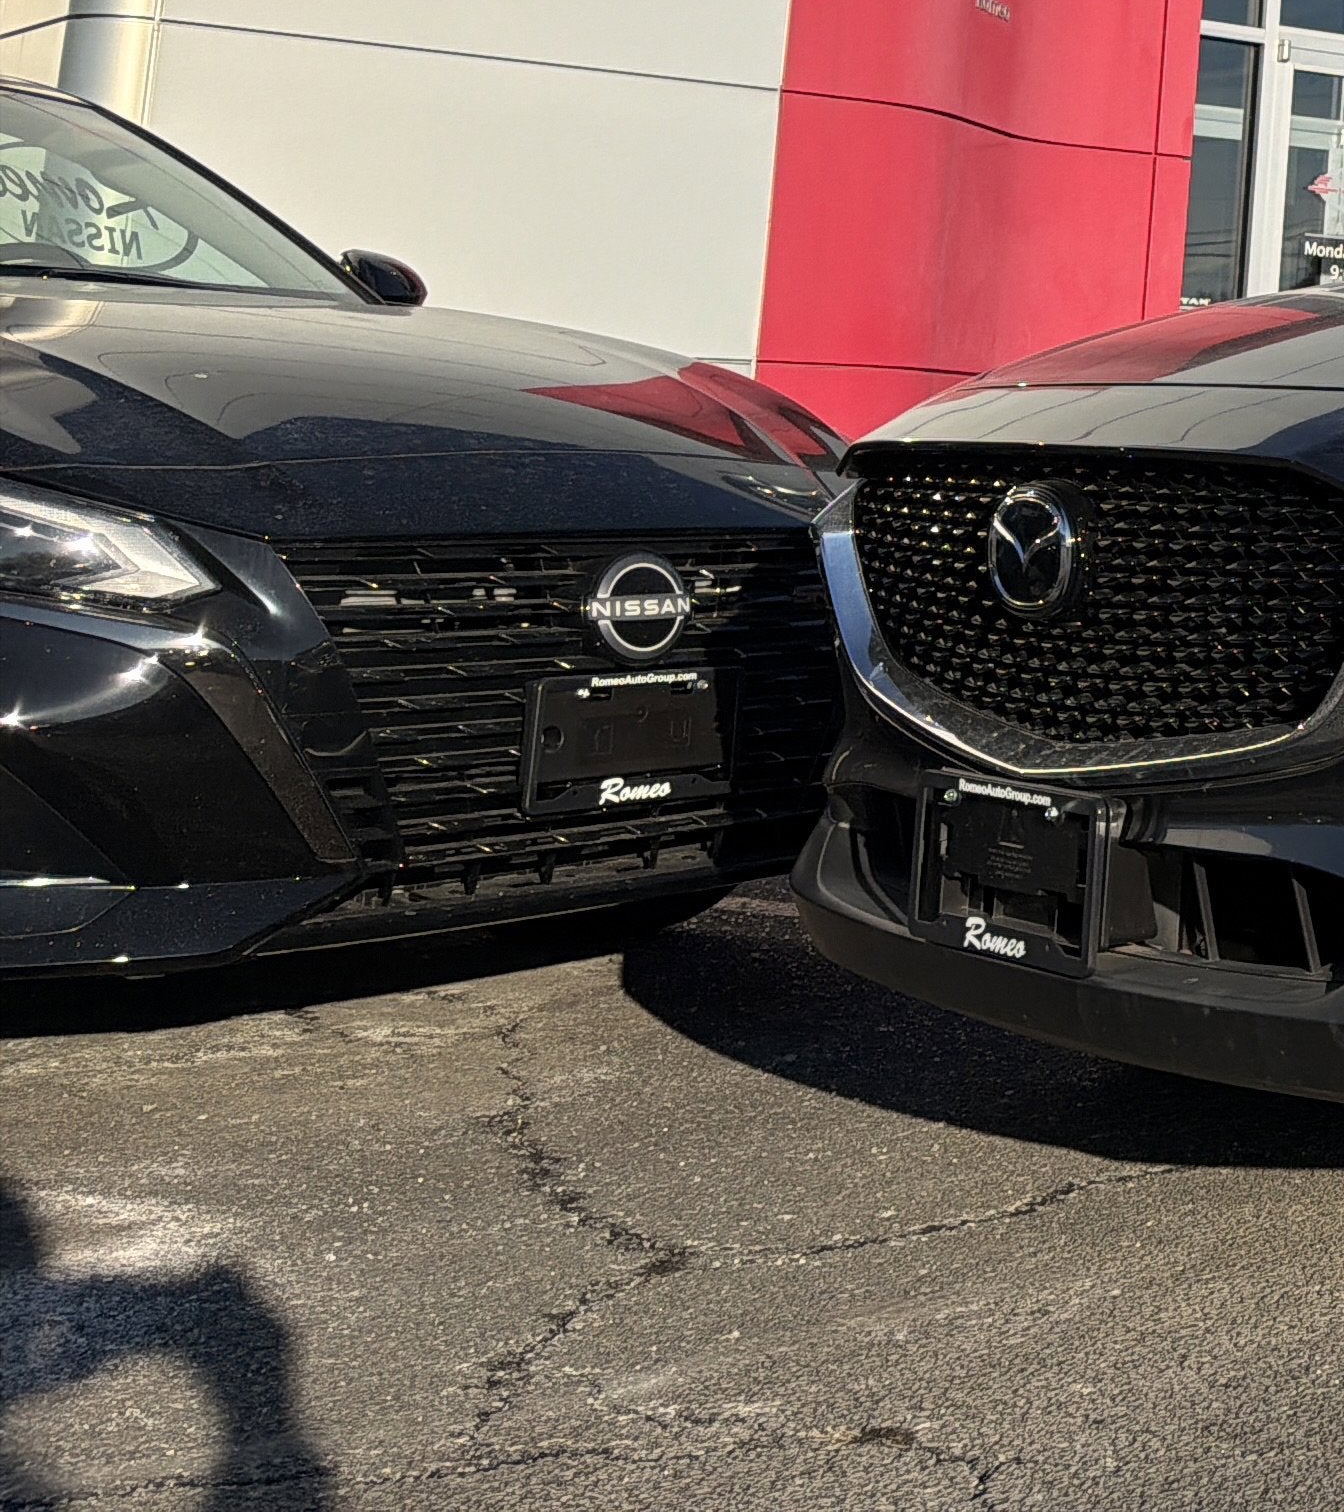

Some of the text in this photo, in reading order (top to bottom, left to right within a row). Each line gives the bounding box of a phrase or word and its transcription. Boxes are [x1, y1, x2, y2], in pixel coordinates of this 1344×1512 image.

[591, 597, 690, 617] NISSAN
[591, 672, 697, 688] RomeoAutoGroup.com
[599, 777, 671, 805] Romeo
[959, 778, 1052, 807] RomeoAutoGroup.com
[963, 916, 1026, 959] Romeo
